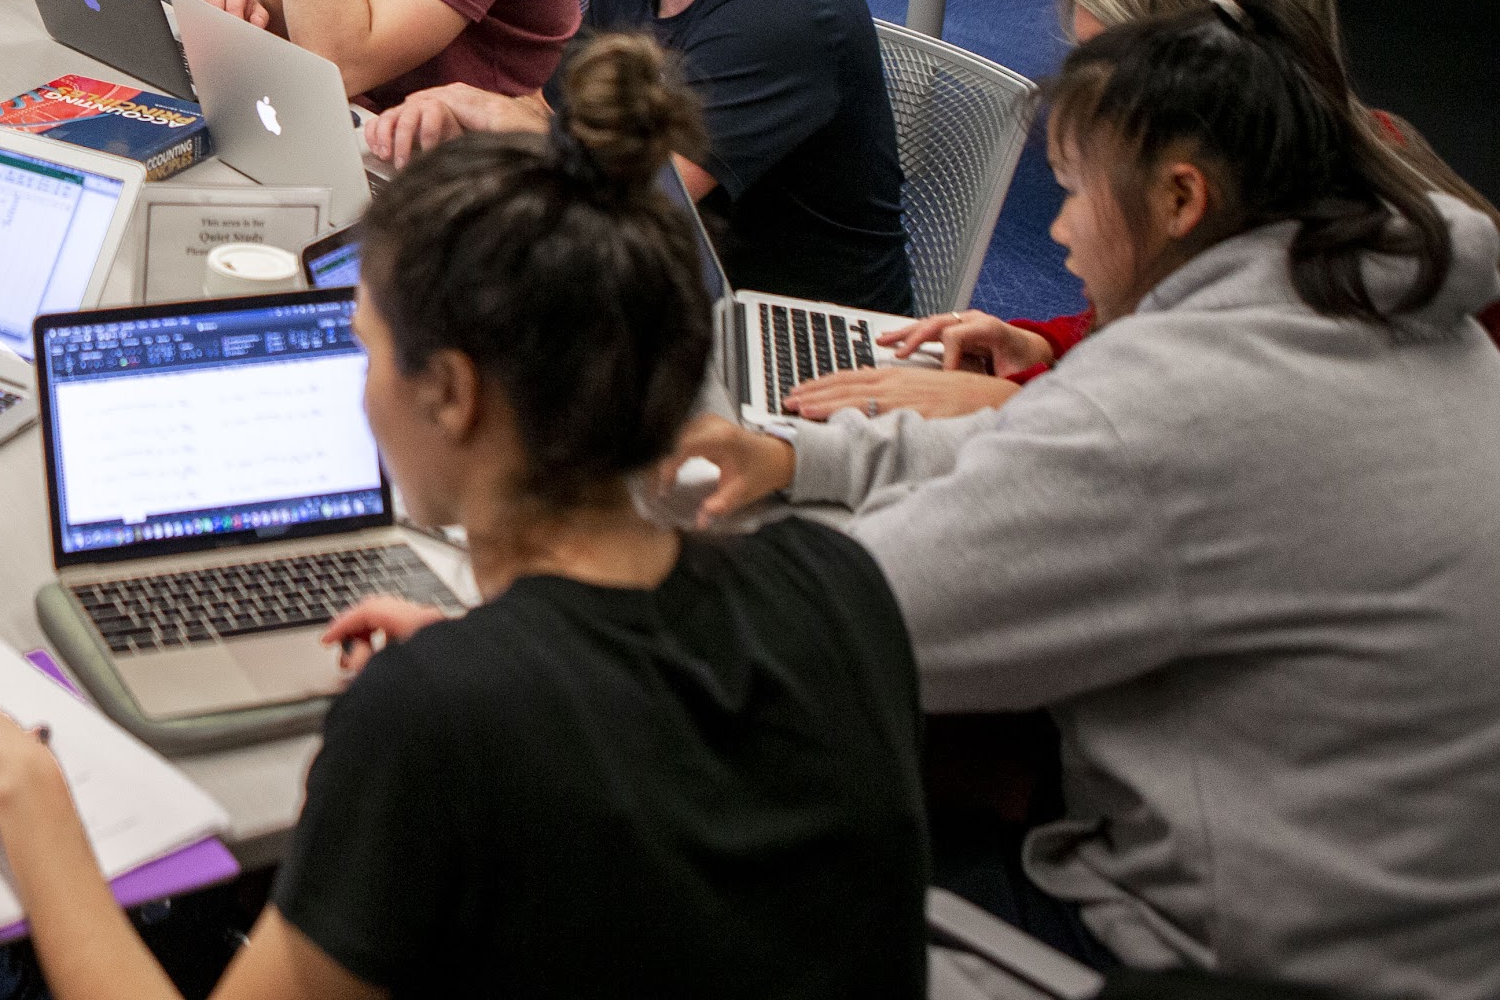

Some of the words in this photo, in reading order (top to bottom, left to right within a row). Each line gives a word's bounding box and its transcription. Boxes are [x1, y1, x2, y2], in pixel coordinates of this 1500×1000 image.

[44, 91, 187, 128] ACCOUNTING
[56, 86, 197, 125] PRINCIPLES
[146, 139, 193, 171] CCOUNTING
